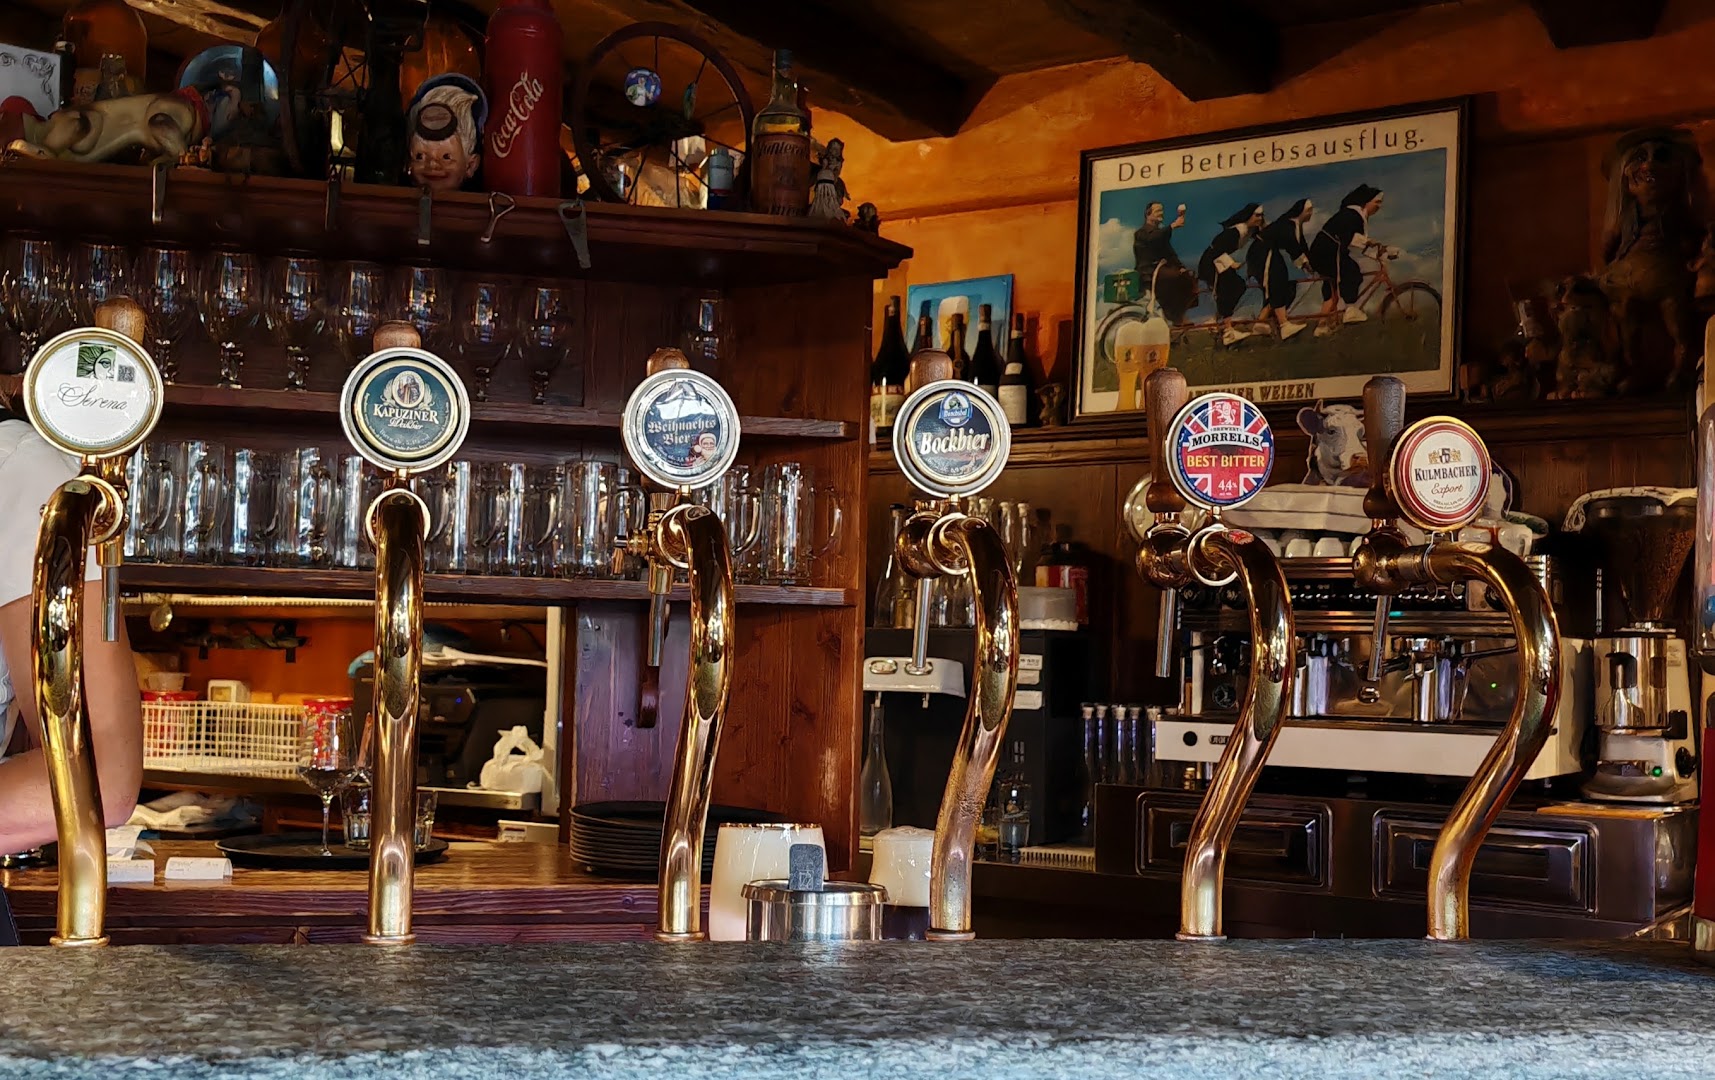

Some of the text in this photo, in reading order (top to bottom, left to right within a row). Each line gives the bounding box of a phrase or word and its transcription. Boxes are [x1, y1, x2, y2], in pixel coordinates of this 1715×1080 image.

[1118, 127, 1425, 182] Der Betriebsausflug.
[57, 382, 128, 411] Serena
[1259, 382, 1315, 401] WEIZEN
[372, 403, 440, 425] KAPUZINER
[647, 418, 717, 434] Weihnachts
[662, 432, 692, 446] Bier
[919, 427, 990, 455] Bockbier
[1191, 432, 1260, 448] MORRELLS
[1186, 455, 1266, 468] BEST BITTER
[1414, 465, 1478, 482] KULMBACHER
[1430, 482, 1464, 498] Export
